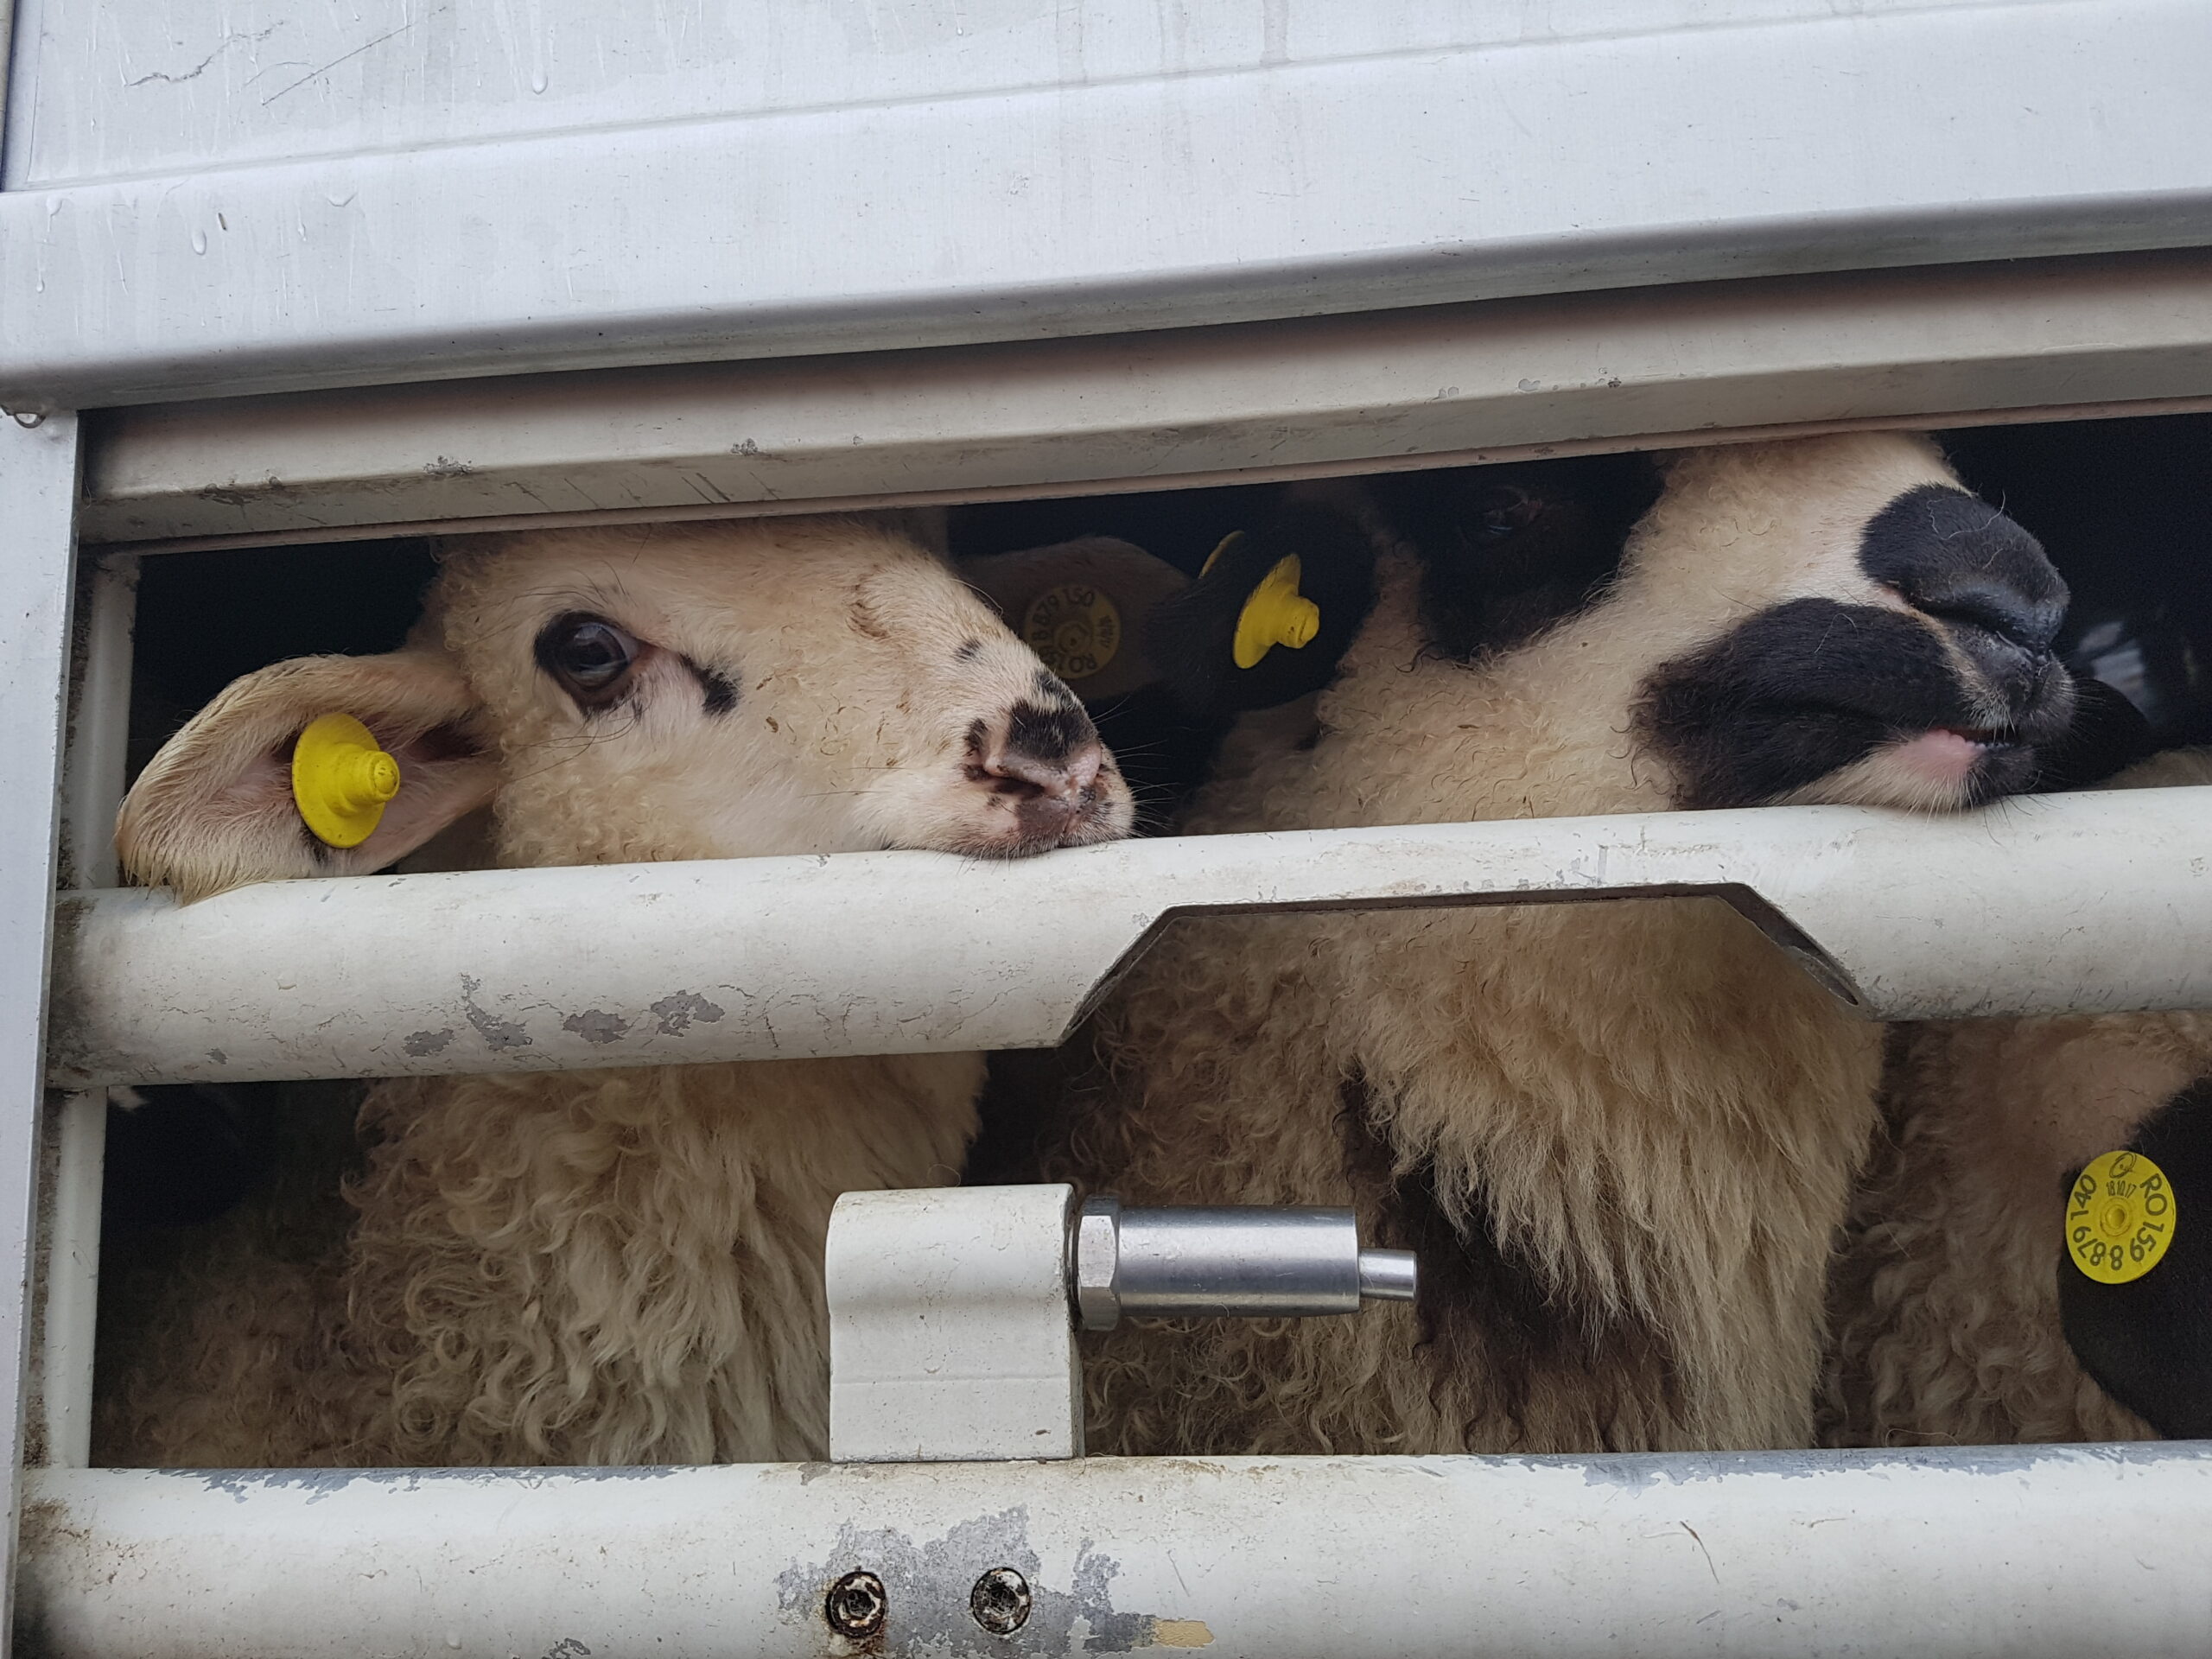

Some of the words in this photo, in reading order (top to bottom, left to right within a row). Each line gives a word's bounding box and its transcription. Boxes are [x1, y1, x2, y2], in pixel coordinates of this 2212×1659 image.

[2070, 1174, 2097, 1221] 140
[2139, 1173, 2168, 1216] RO
[2129, 1222, 2164, 1262] 159
